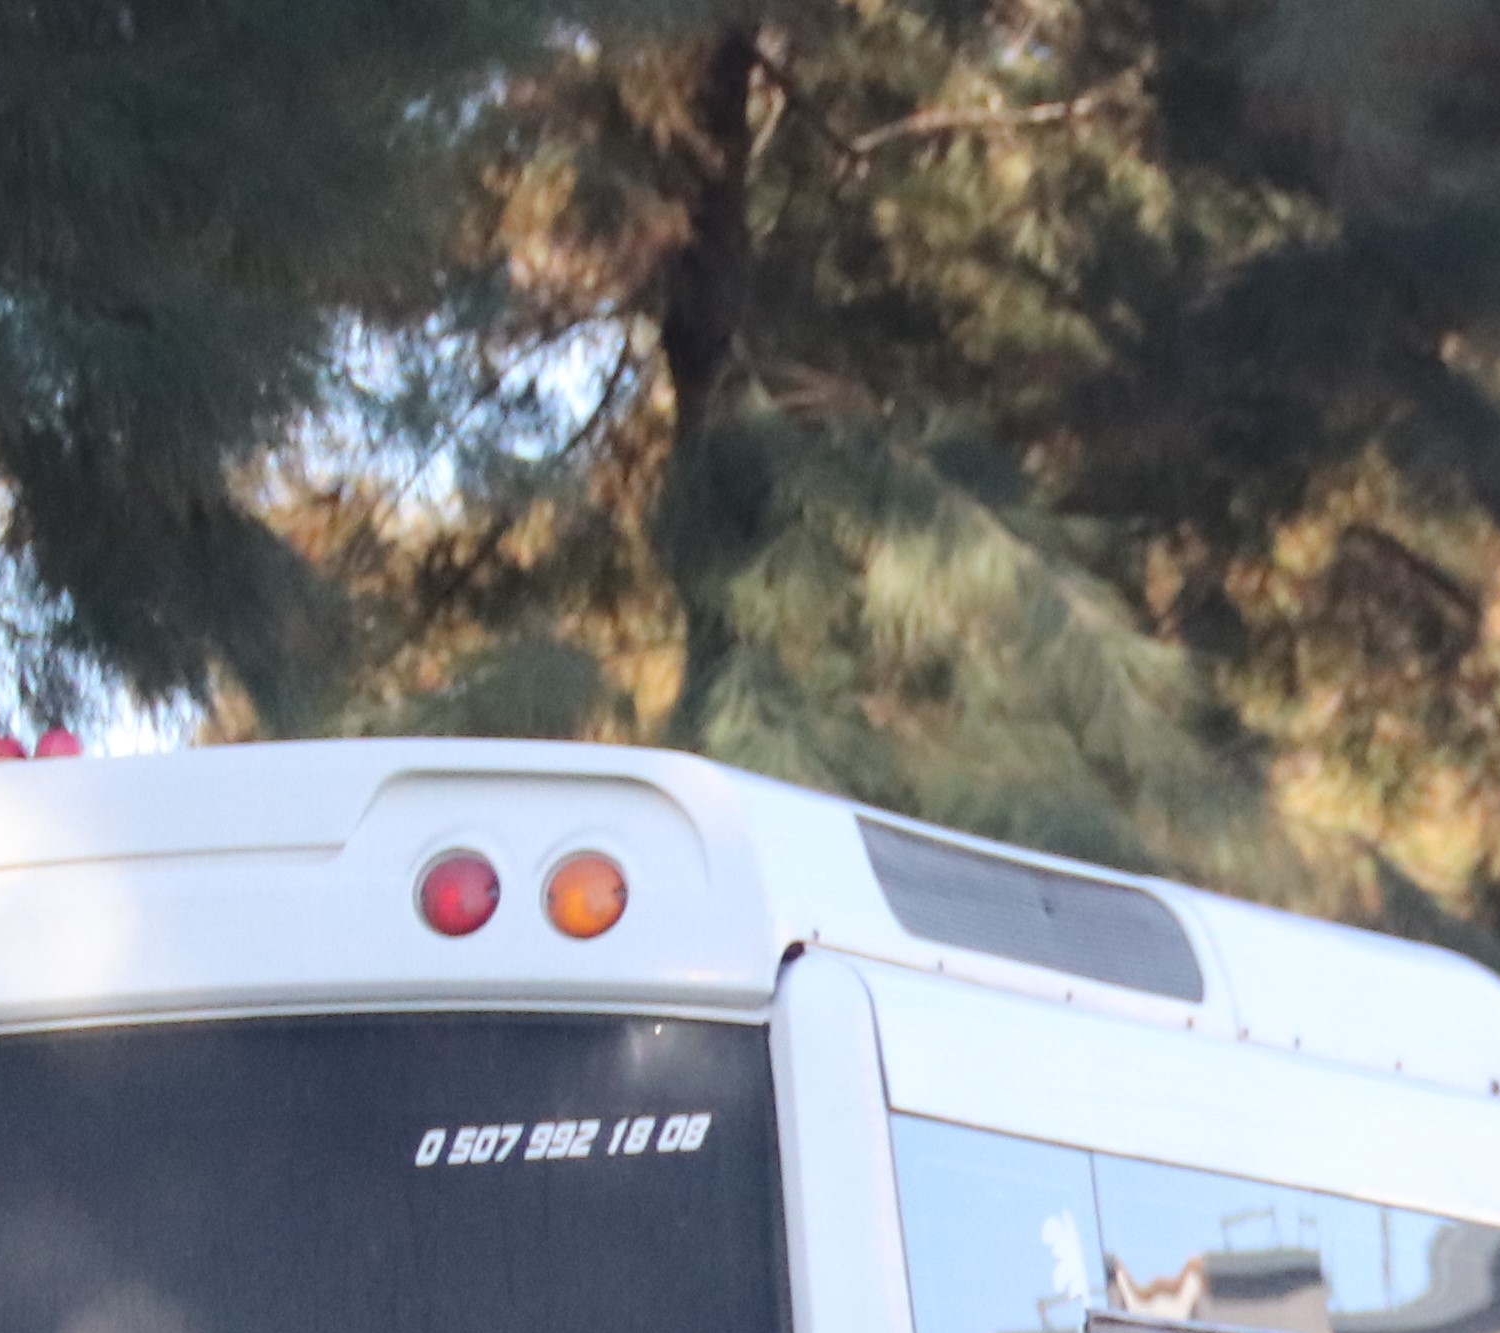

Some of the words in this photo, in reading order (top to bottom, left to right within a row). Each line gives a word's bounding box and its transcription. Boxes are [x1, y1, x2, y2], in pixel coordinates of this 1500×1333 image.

[414, 1128, 447, 1167] 0
[447, 1122, 524, 1165] 507
[524, 1118, 601, 1161] 992
[607, 1115, 656, 1156] 18
[656, 1112, 712, 1153] 08
